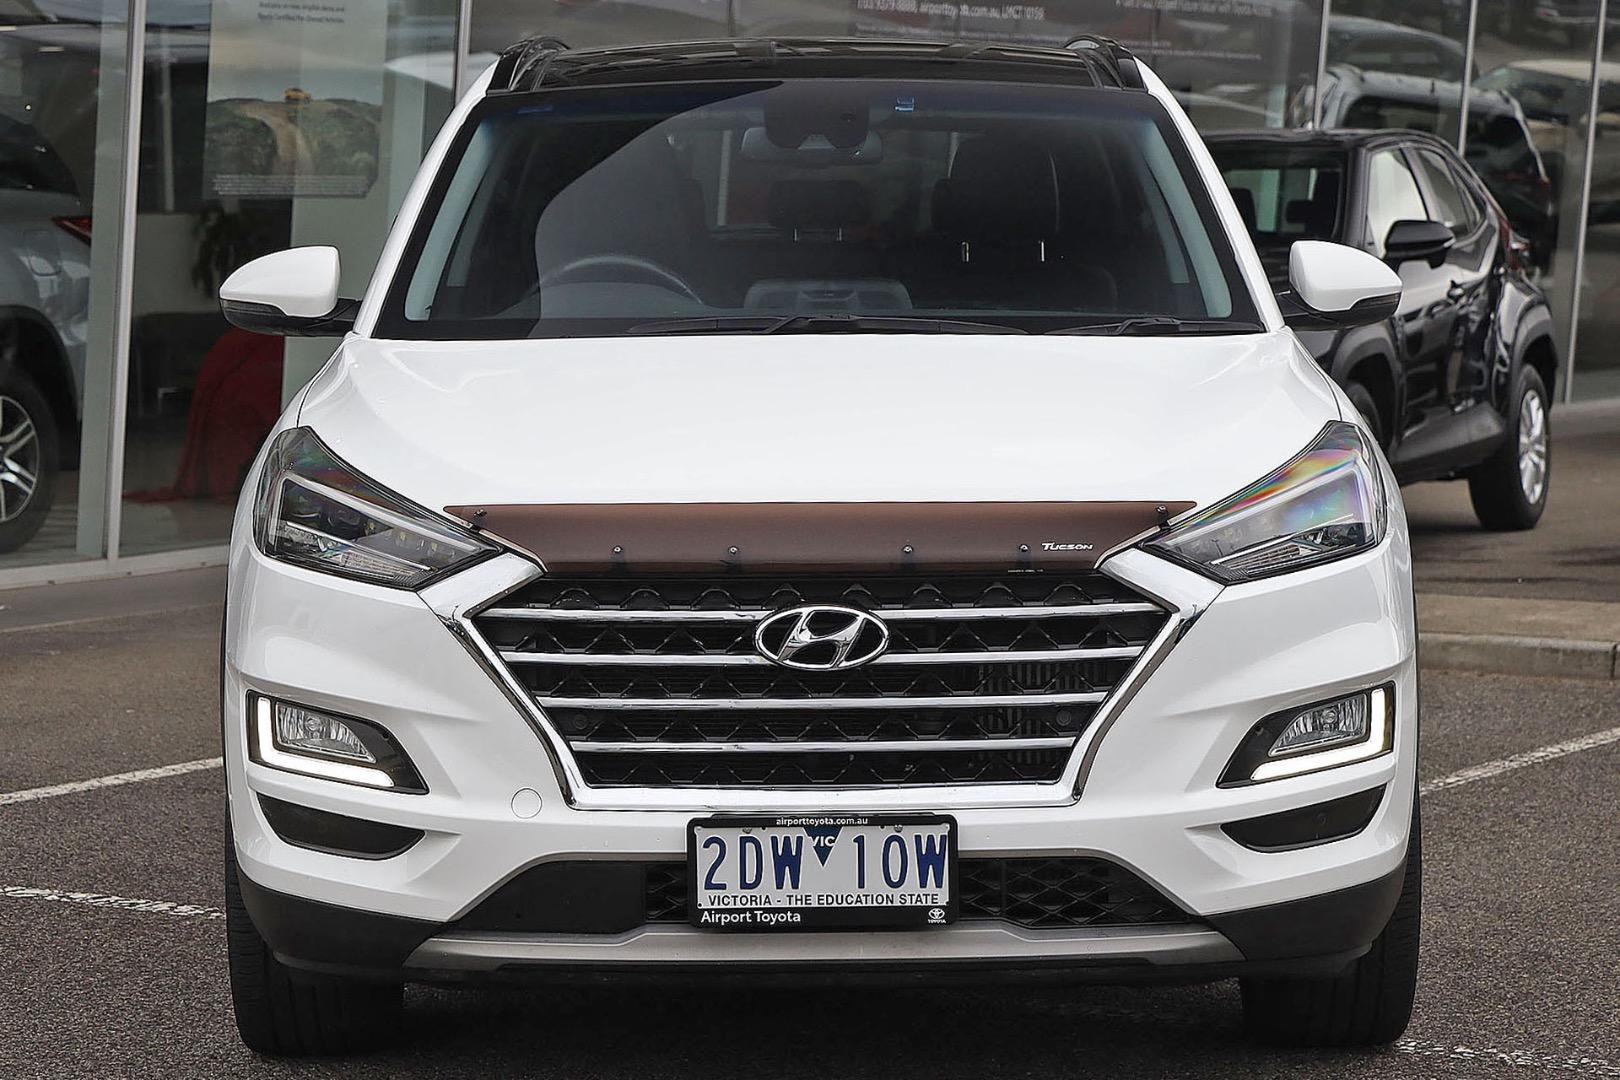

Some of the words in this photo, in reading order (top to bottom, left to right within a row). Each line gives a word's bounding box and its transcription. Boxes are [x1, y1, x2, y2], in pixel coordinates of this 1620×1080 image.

[776, 816, 868, 827] airporttoyota.com.au
[702, 836, 804, 891] 2DW
[708, 894, 772, 906] VICTORIA
[786, 894, 812, 906] THE
[817, 893, 894, 905] EDUCATION
[899, 893, 939, 905] STATE
[700, 910, 752, 925] Airport
[753, 910, 801, 925] Toyota
